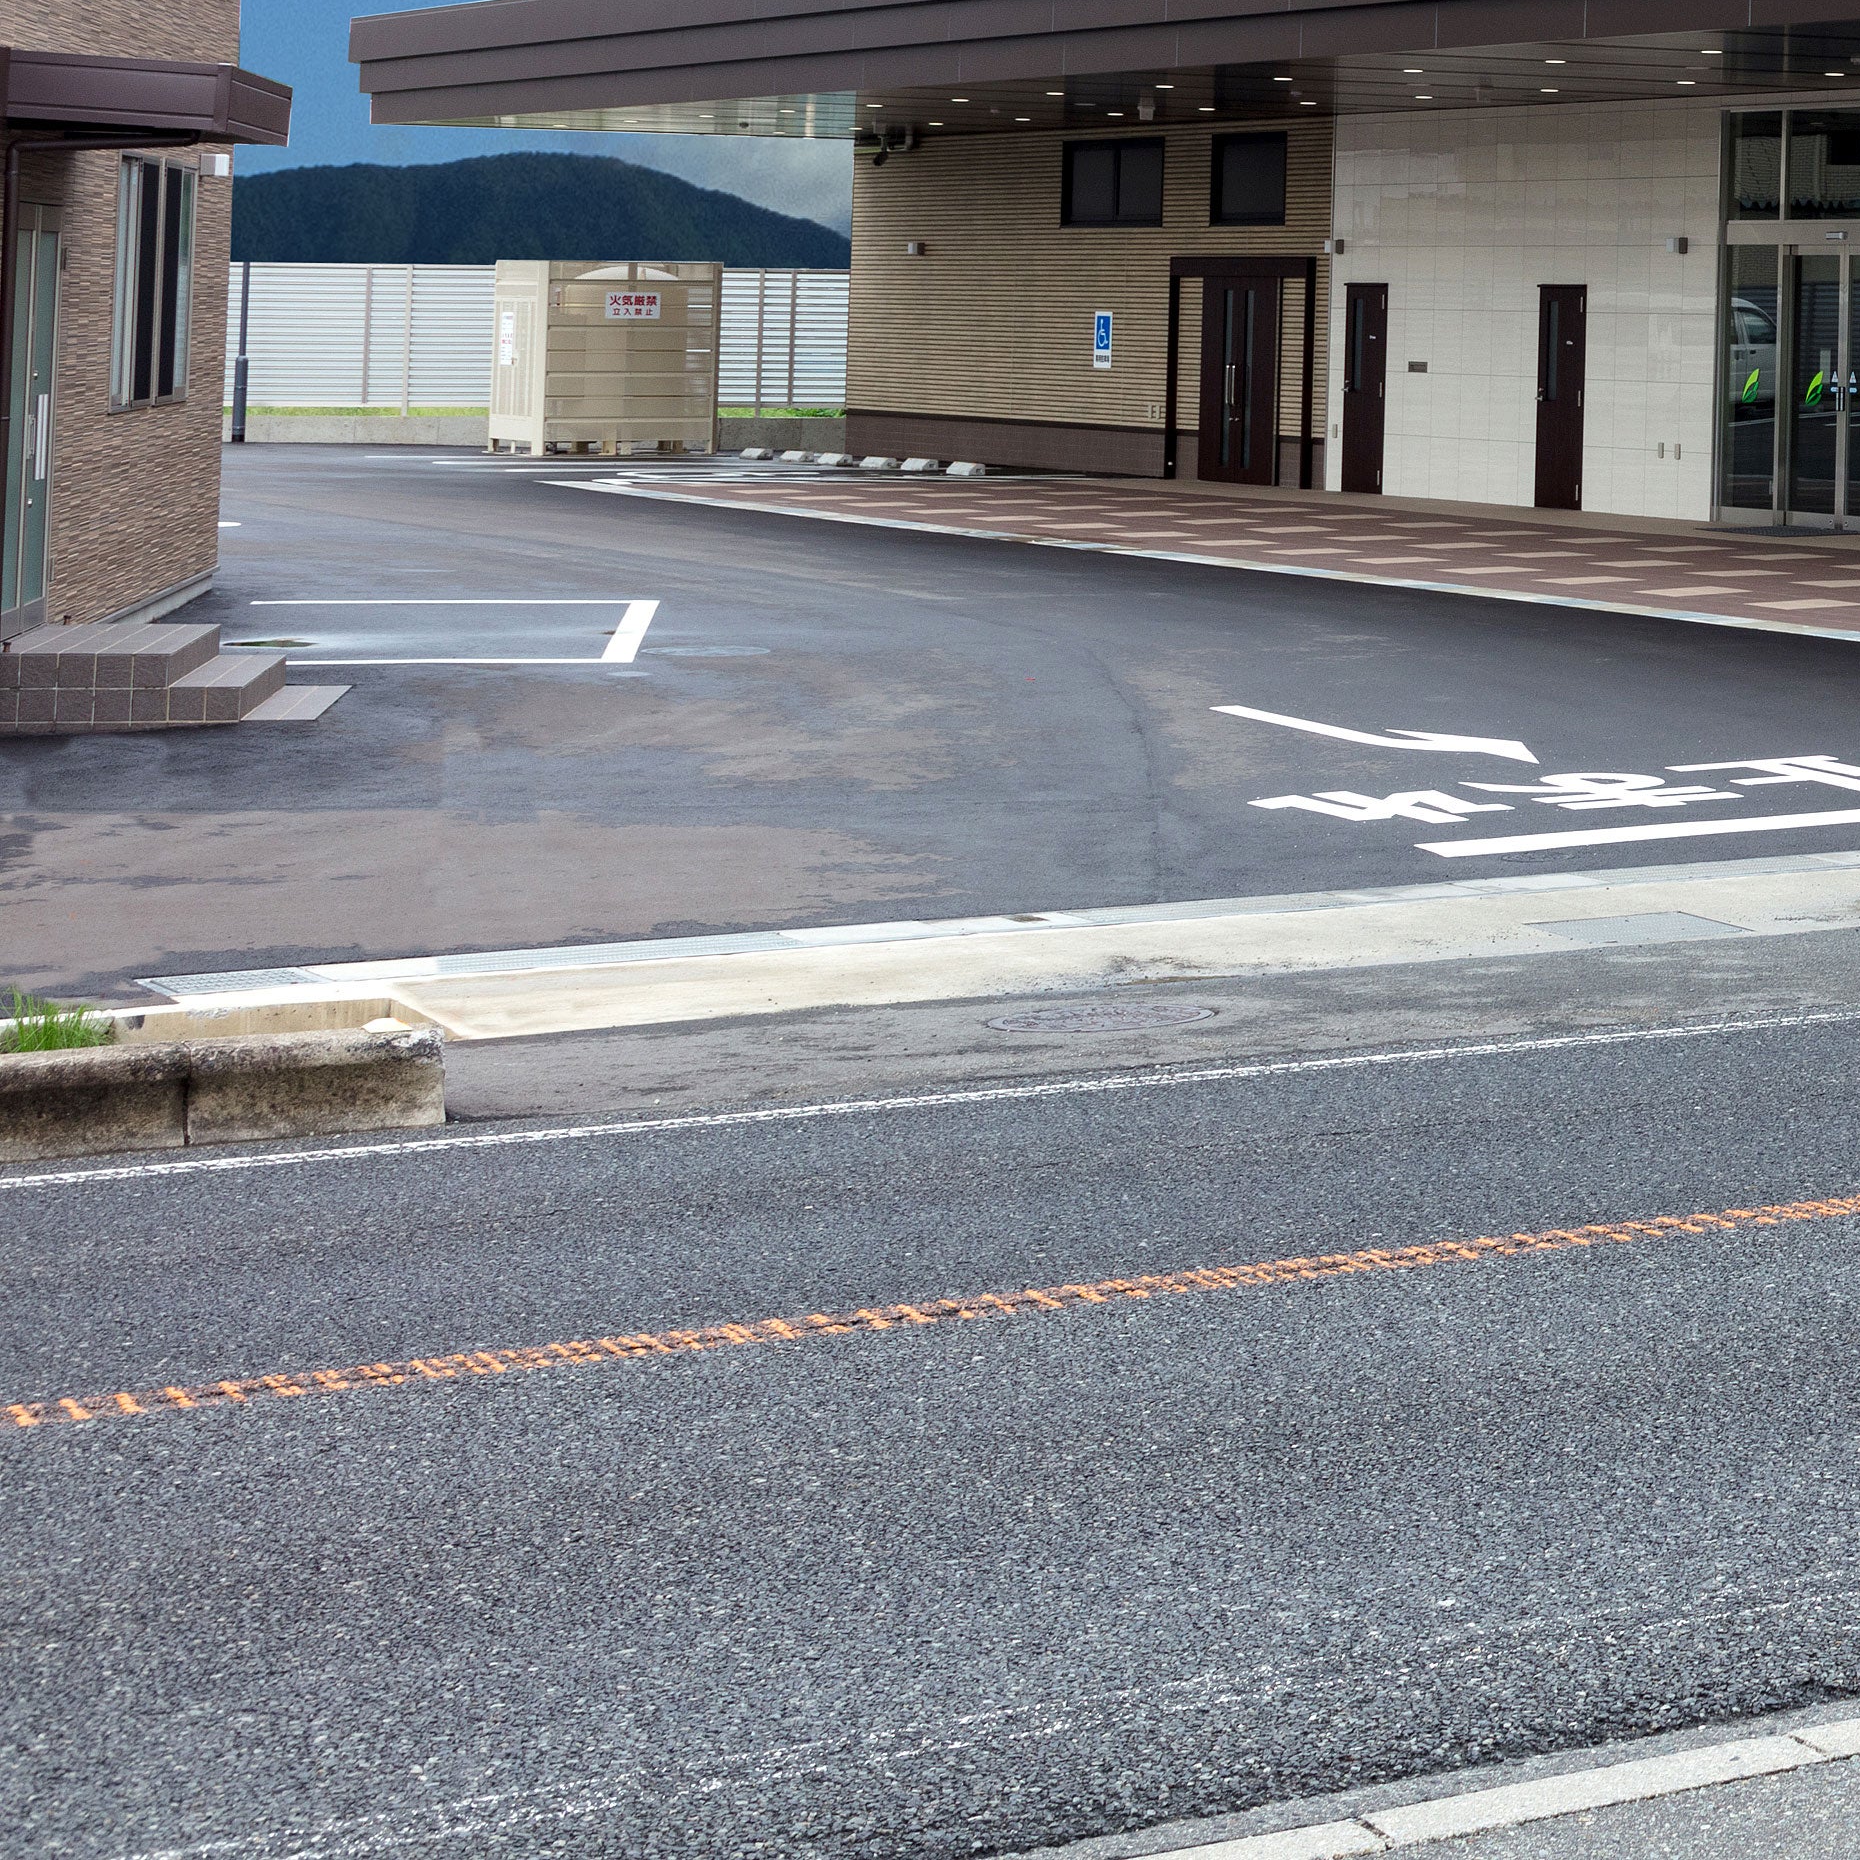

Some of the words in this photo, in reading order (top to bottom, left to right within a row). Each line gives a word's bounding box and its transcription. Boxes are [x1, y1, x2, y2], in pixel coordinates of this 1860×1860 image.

[610, 295, 657, 306] 火気厳禁
[612, 308, 653, 316] 立入禁止
